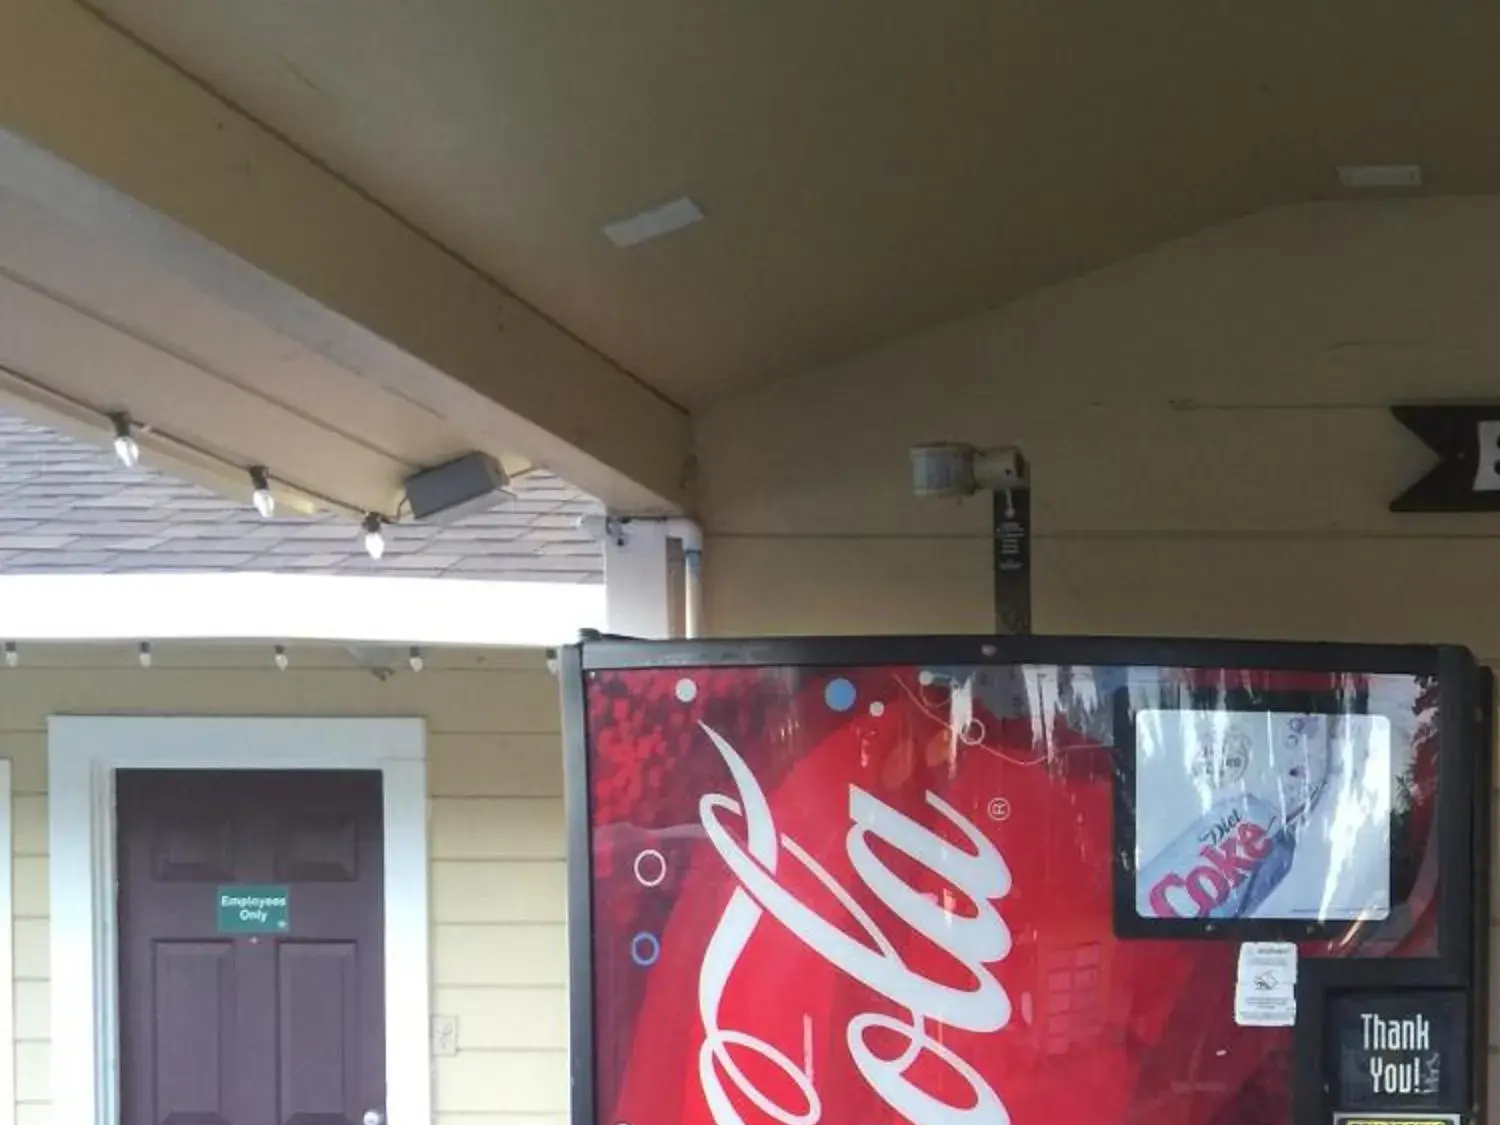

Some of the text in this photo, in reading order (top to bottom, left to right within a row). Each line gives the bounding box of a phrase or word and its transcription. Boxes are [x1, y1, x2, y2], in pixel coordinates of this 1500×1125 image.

[1198, 808, 1243, 845] Diet
[1149, 822, 1274, 918] Coke
[221, 895, 287, 909] Employees
[239, 909, 268, 924] Only
[1360, 1013, 1430, 1051] Thank
[1369, 1056, 1421, 1093] You!
